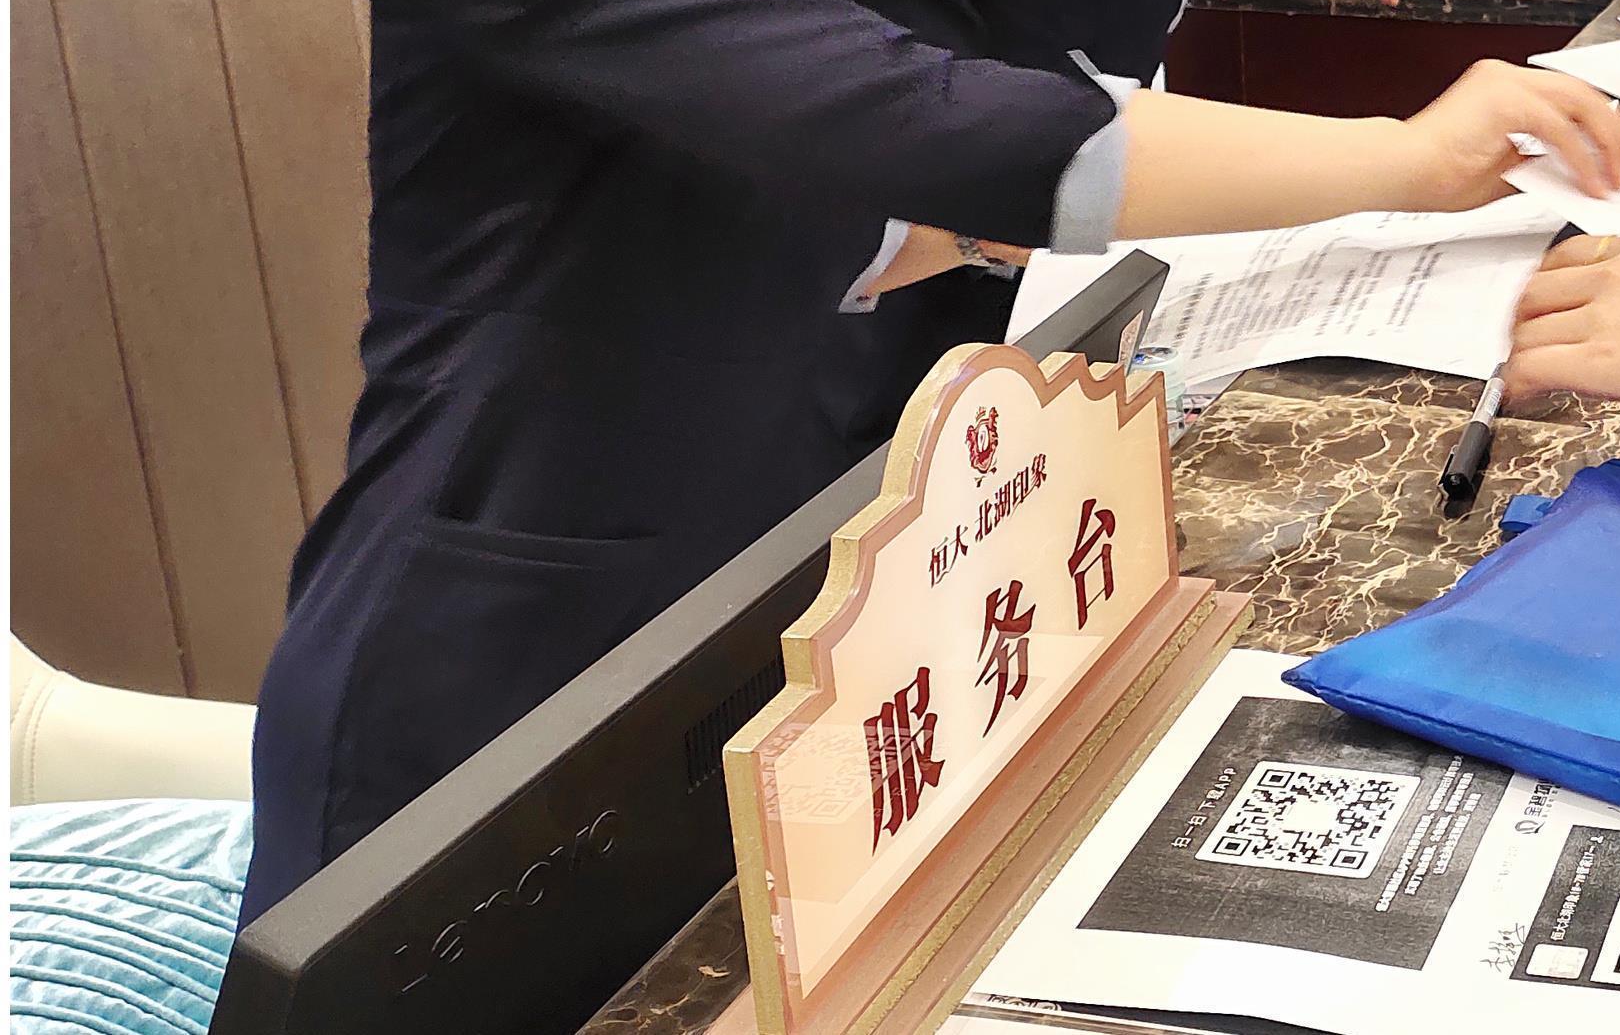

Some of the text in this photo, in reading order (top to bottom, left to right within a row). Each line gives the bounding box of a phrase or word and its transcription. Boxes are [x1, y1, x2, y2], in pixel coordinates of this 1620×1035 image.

[929, 453, 1048, 589] 恒大 北湖印象
[863, 498, 1116, 857] 服务台
